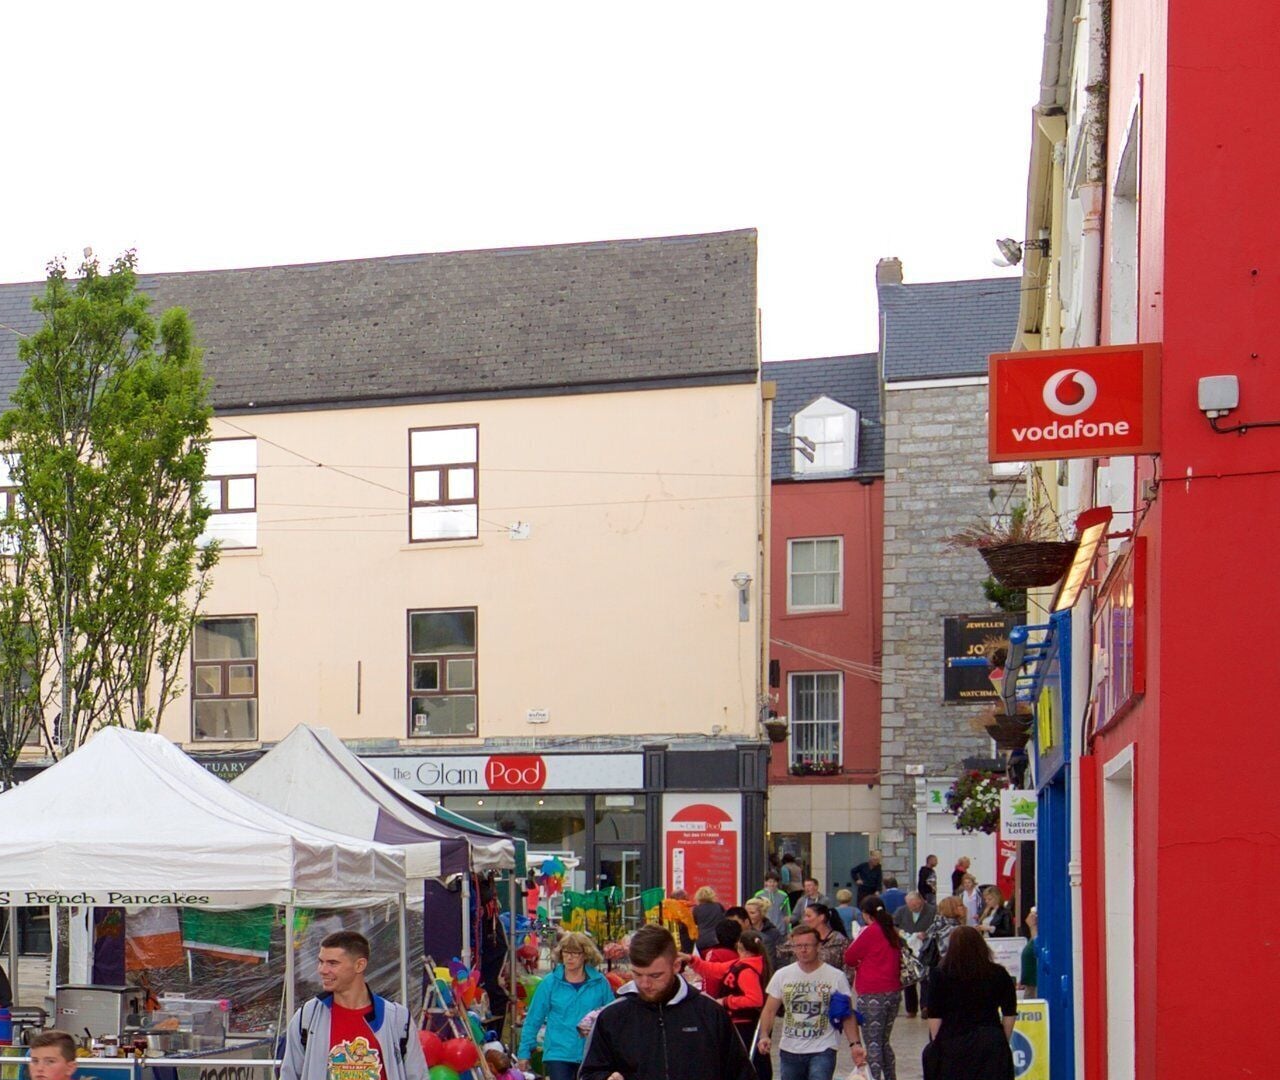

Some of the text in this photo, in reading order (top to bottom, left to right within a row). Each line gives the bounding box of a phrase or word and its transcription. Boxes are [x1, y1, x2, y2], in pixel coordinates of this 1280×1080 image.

[1011, 419, 1129, 442] vodafone
[393, 761, 540, 786] The Glam Pod
[25, 892, 96, 904] French
[108, 892, 209, 905] Pancakes
